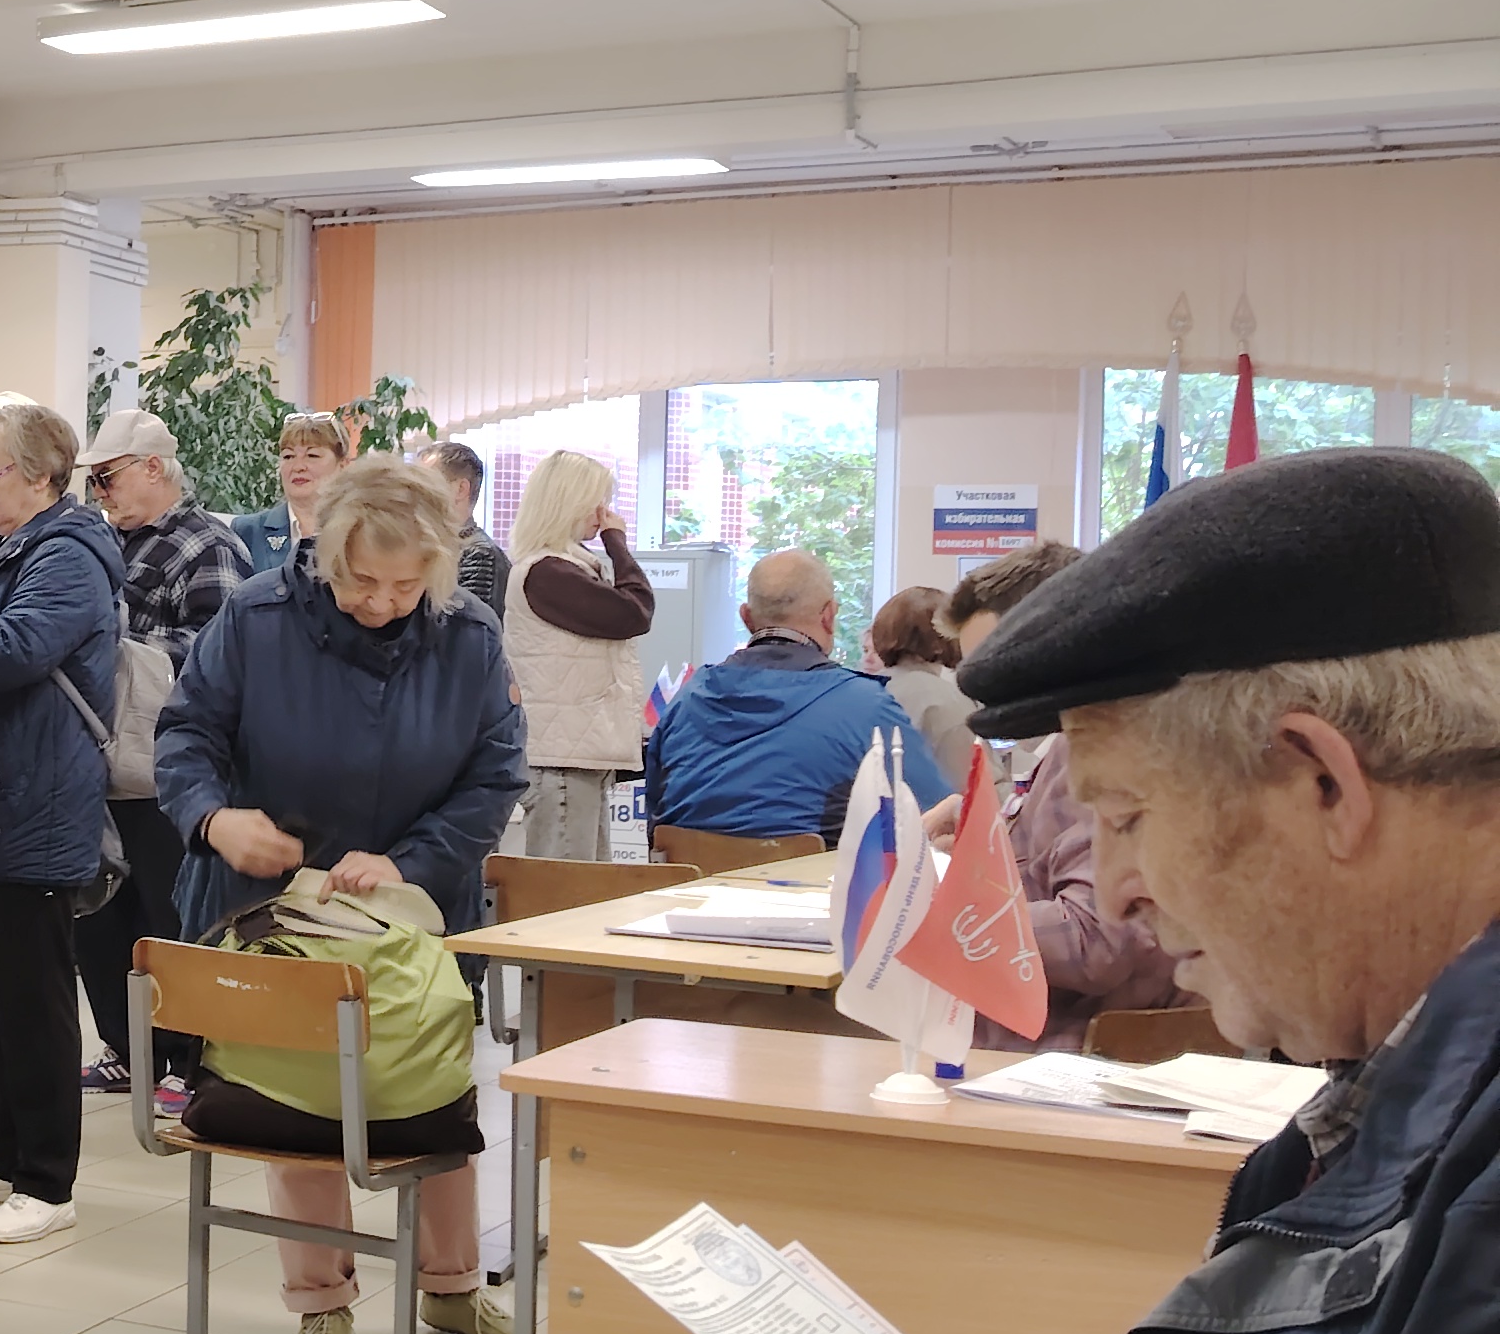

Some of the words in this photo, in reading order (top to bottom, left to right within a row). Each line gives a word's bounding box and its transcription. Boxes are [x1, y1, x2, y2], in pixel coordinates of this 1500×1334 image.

[956, 490, 1016, 501] Участковая
[945, 512, 1026, 525] избирательная
[935, 538, 984, 548] комиссия
[610, 804, 630, 822] 18
